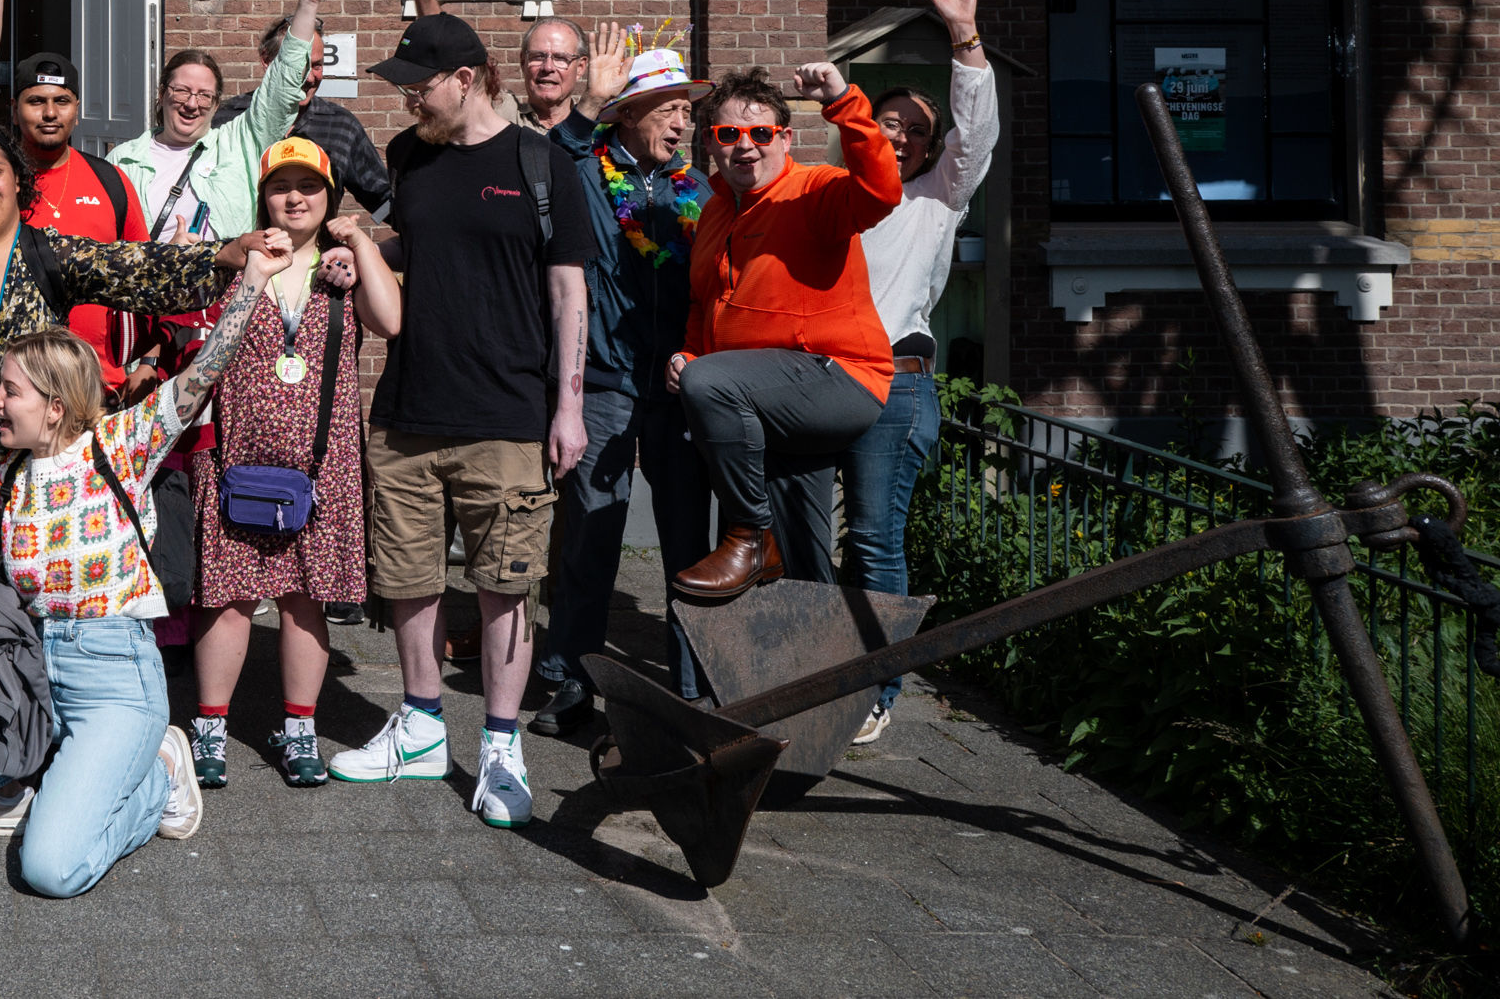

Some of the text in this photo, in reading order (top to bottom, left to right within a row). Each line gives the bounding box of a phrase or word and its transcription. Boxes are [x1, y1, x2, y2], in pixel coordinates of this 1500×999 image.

[1170, 81, 1209, 96] 29 juni
[1181, 112, 1199, 120] DAG
[76, 196, 100, 205] FILA
